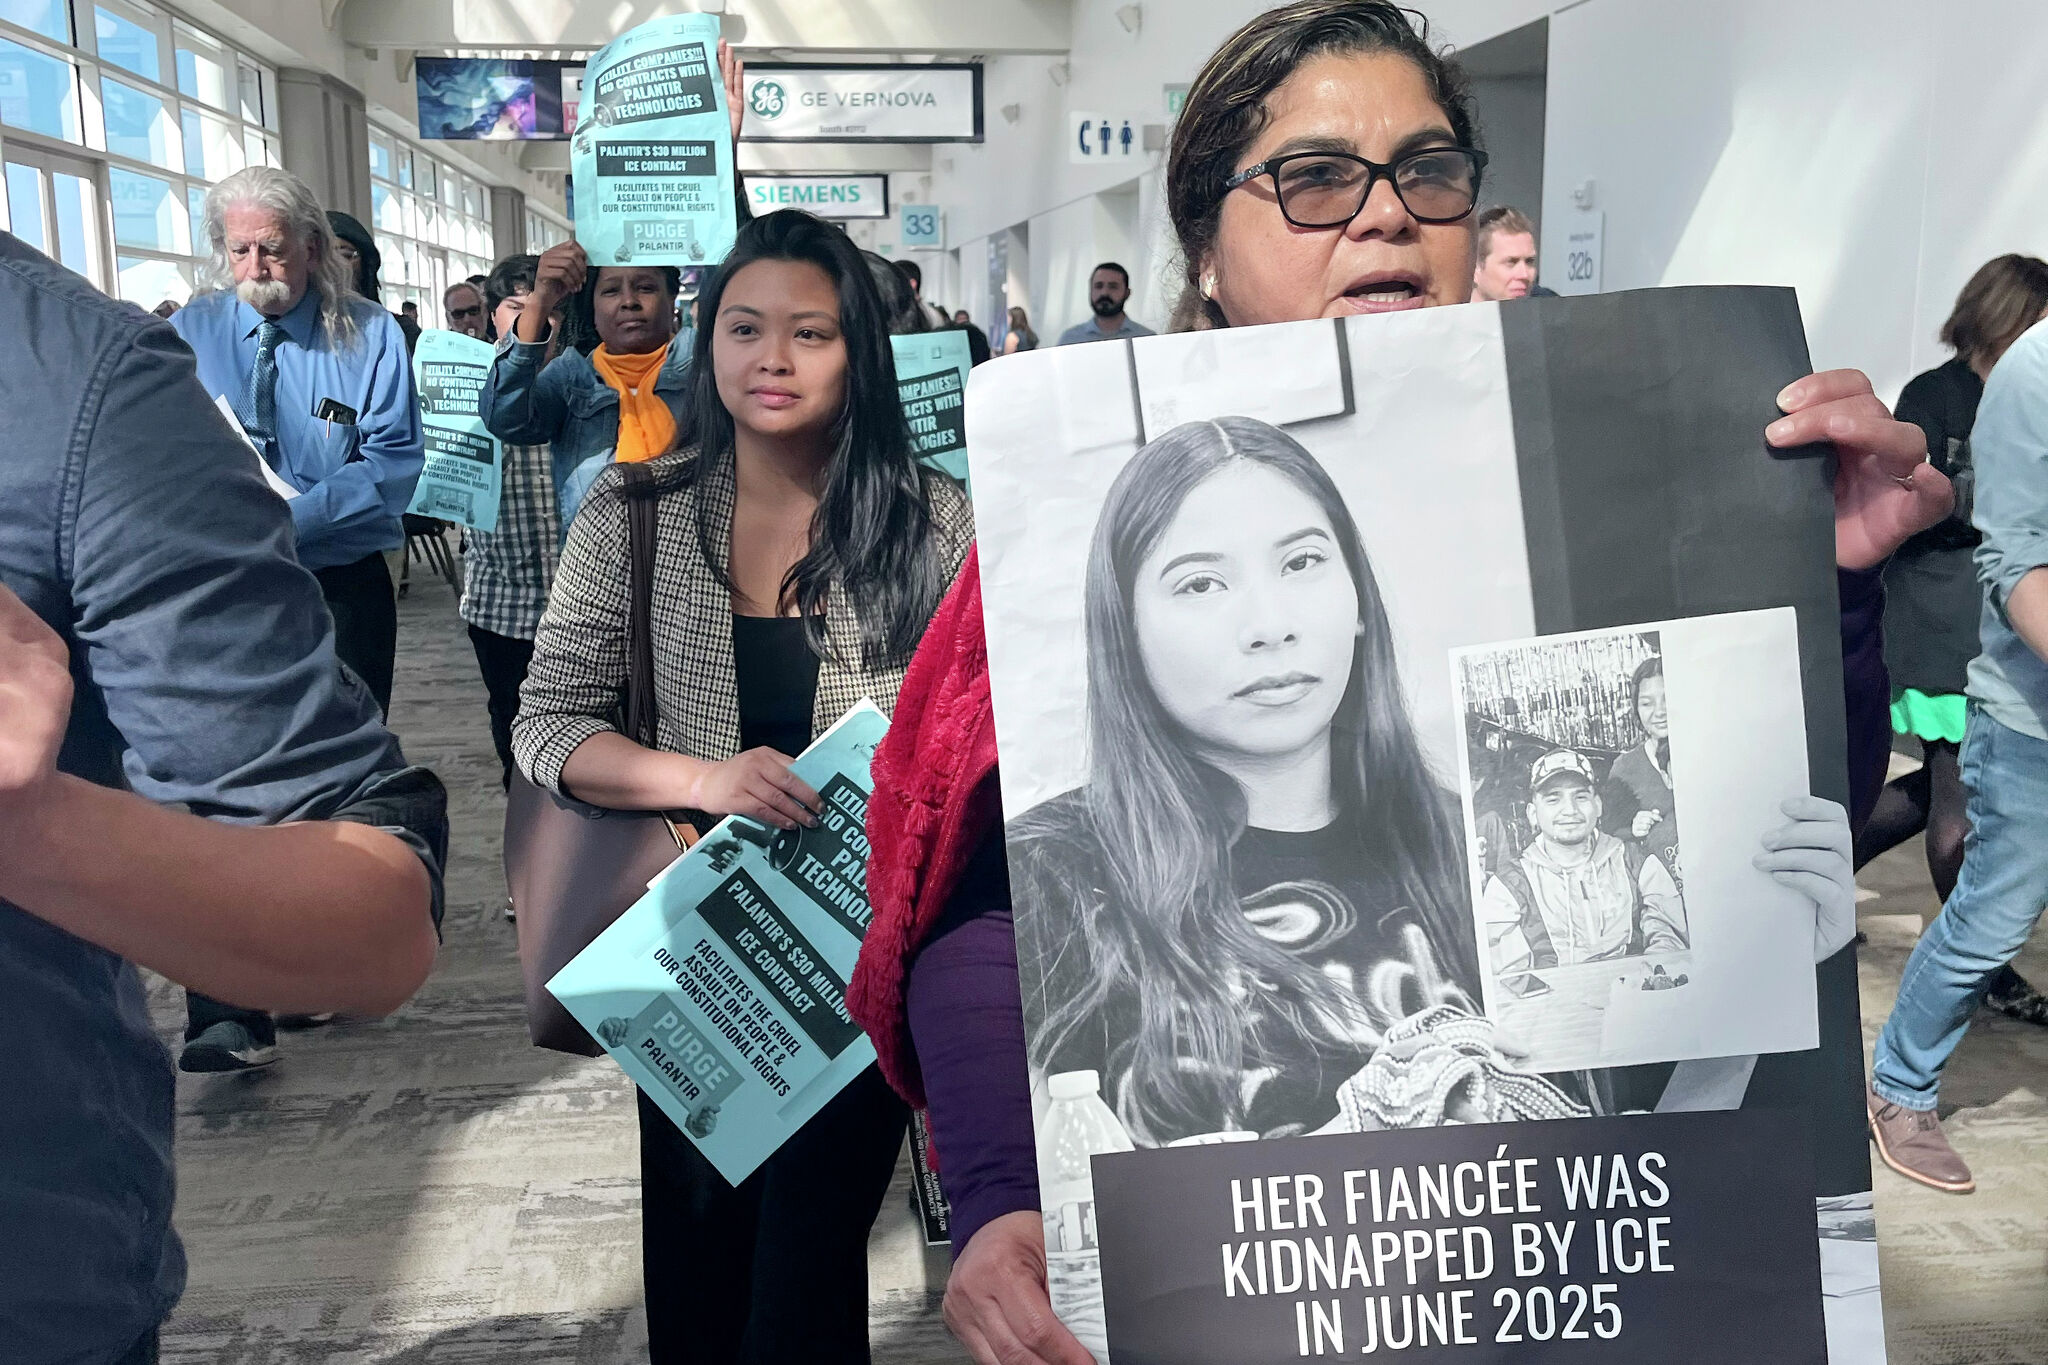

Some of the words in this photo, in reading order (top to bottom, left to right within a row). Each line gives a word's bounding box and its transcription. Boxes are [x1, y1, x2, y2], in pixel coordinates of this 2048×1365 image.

[600, 82, 614, 95] NO
[616, 67, 677, 89] CONTRACTS
[678, 63, 706, 78] WITH
[623, 81, 683, 102] PALANTIR
[613, 94, 702, 119] TECHNOLOGIES
[801, 92, 828, 107] GE
[835, 91, 937, 107] VERNOVA
[600, 146, 650, 156] PALANTIR'S
[671, 146, 707, 156] MILLION
[624, 161, 639, 171] ICE
[641, 161, 686, 171] CONTRACT
[614, 183, 659, 192] FACILITATES
[661, 183, 676, 192] THE
[678, 183, 702, 192] CRUEL
[617, 193, 649, 202] ASSAULT
[651, 193, 662, 202] ON
[665, 193, 692, 202] PEOPLE
[754, 184, 860, 203] SIEMENS
[602, 203, 619, 213] OUR
[621, 203, 685, 213] CONSTITUTIONAL
[687, 203, 715, 212] RIGHTS
[633, 223, 687, 239] PURGE
[906, 214, 935, 235] 33
[639, 242, 684, 251] PALANTIR
[426, 377, 438, 387] NO
[833, 785, 868, 824] UTIL
[831, 848, 868, 896] PAL
[797, 853, 873, 930] TECHNOL
[727, 880, 793, 951] PALANTIR'S
[787, 946, 815, 975] $30
[735, 927, 761, 955] ICE
[754, 949, 816, 1014] CONTRACT
[683, 955, 730, 1006] ASSAULT
[724, 999, 744, 1019] ON
[738, 1014, 779, 1058] PEOPLE
[774, 1053, 787, 1067] &
[694, 938, 754, 1003] FACILITATES
[749, 998, 773, 1024] THE
[768, 1020, 802, 1058] CRUEL
[653, 947, 680, 976] OUR
[675, 971, 755, 1060] CONSTITUTIONAL
[750, 1054, 791, 1097] RIGHTS
[653, 1010, 729, 1091] PURGE
[641, 1038, 700, 1101] PALANTIR
[1230, 1173, 1328, 1234] HER
[1343, 1144, 1542, 1225] FIANCÉE
[1555, 1151, 1670, 1212] WAS
[1221, 1226, 1494, 1298] KIDNAPPED
[1511, 1220, 1577, 1278] BY
[1597, 1217, 1675, 1275] ICE
[1295, 1300, 1345, 1357] IN
[1361, 1289, 1477, 1355] JUNE
[1492, 1284, 1623, 1343] 2025
